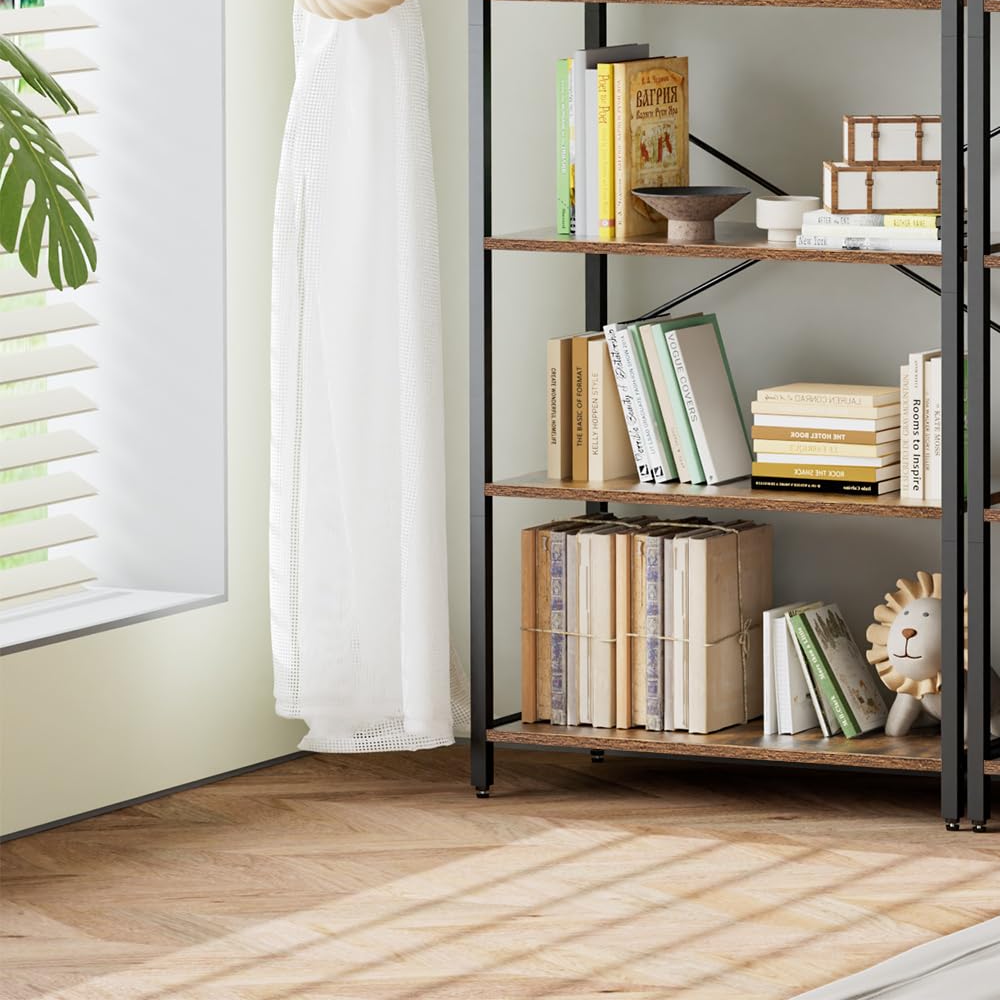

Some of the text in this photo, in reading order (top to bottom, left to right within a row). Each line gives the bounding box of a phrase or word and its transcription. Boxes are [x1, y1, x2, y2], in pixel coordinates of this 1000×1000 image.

[598, 73, 610, 124] Poet Poet
[636, 85, 678, 108] ВАГРИЯ
[624, 348, 633, 366] SHOW
[667, 334, 684, 375] VOGUE
[679, 376, 698, 423] COVERS
[576, 397, 583, 408] OF
[591, 371, 600, 456] KELLY HOPPEN STYLE
[912, 399, 921, 492] Rooms to Inspire
[797, 626, 809, 644] Little
[815, 663, 825, 680] More
